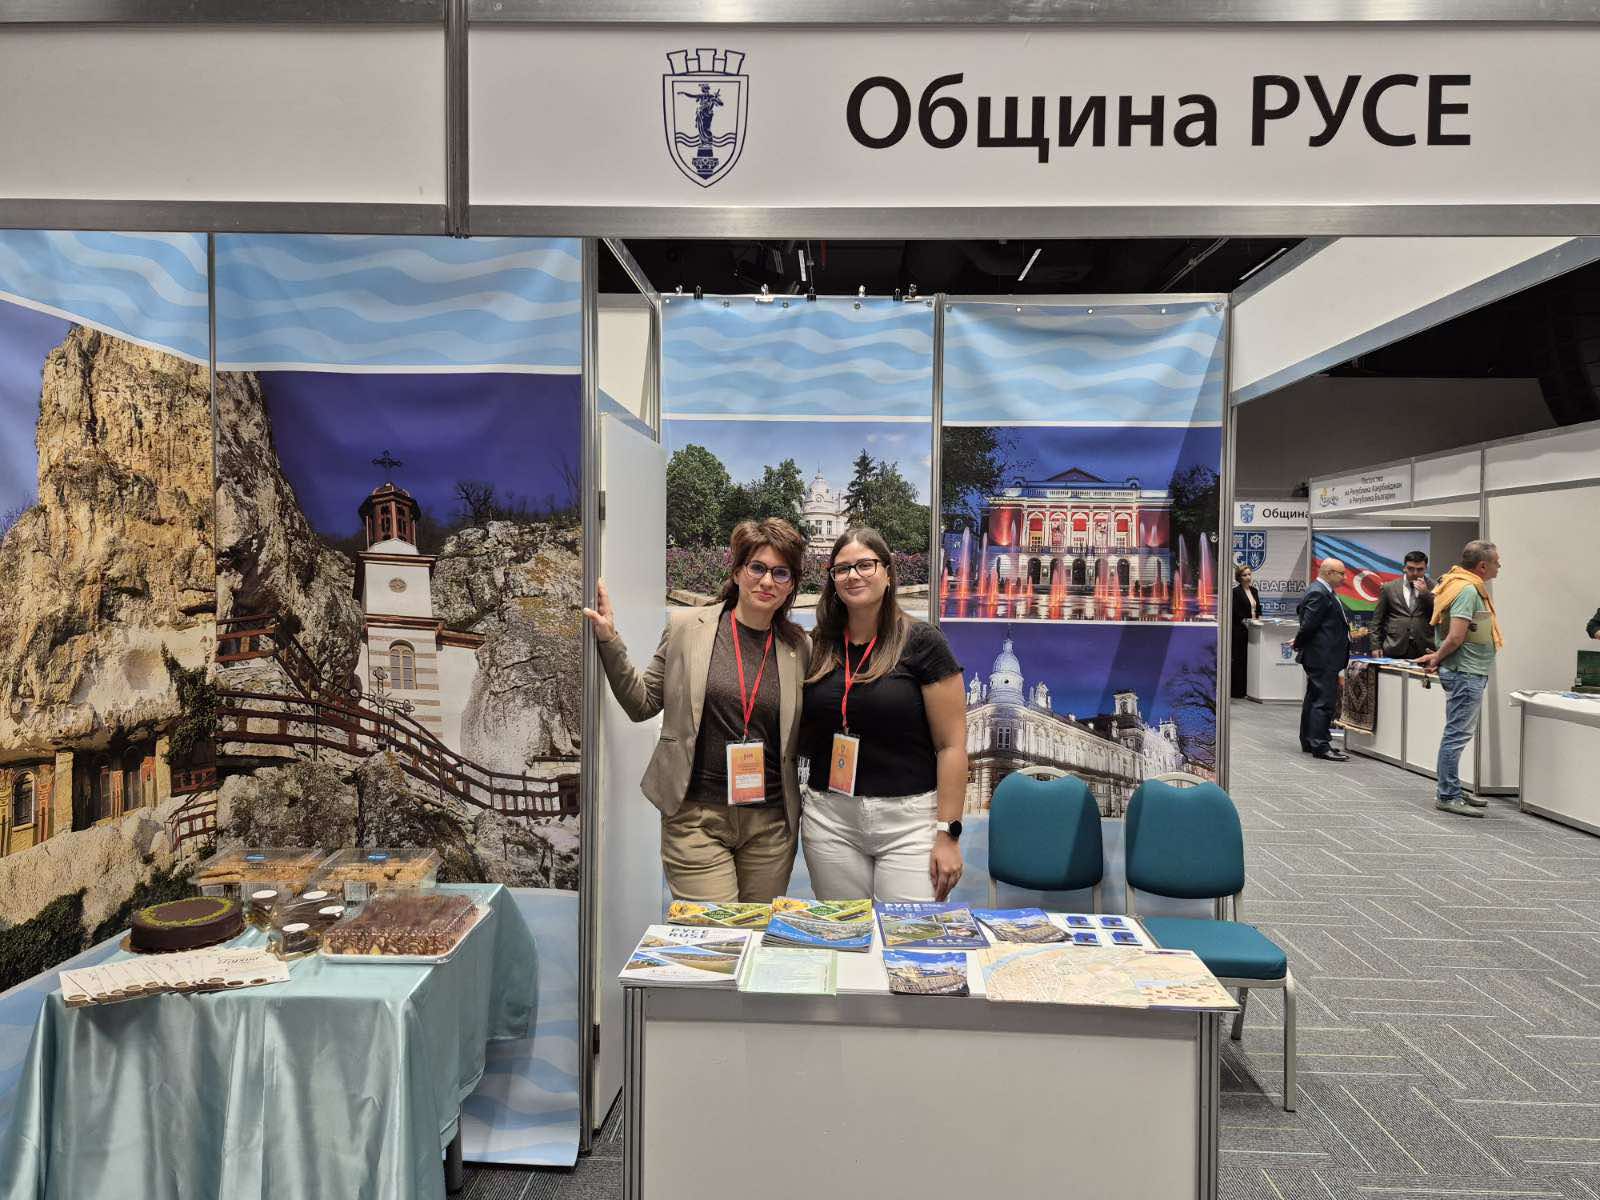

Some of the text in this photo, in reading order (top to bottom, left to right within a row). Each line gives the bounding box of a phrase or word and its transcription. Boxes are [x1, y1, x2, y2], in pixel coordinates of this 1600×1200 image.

[846, 73, 1471, 164] Община РУСЕ
[1262, 508, 1309, 520] Община
[1250, 581, 1307, 593] АВАРНА
